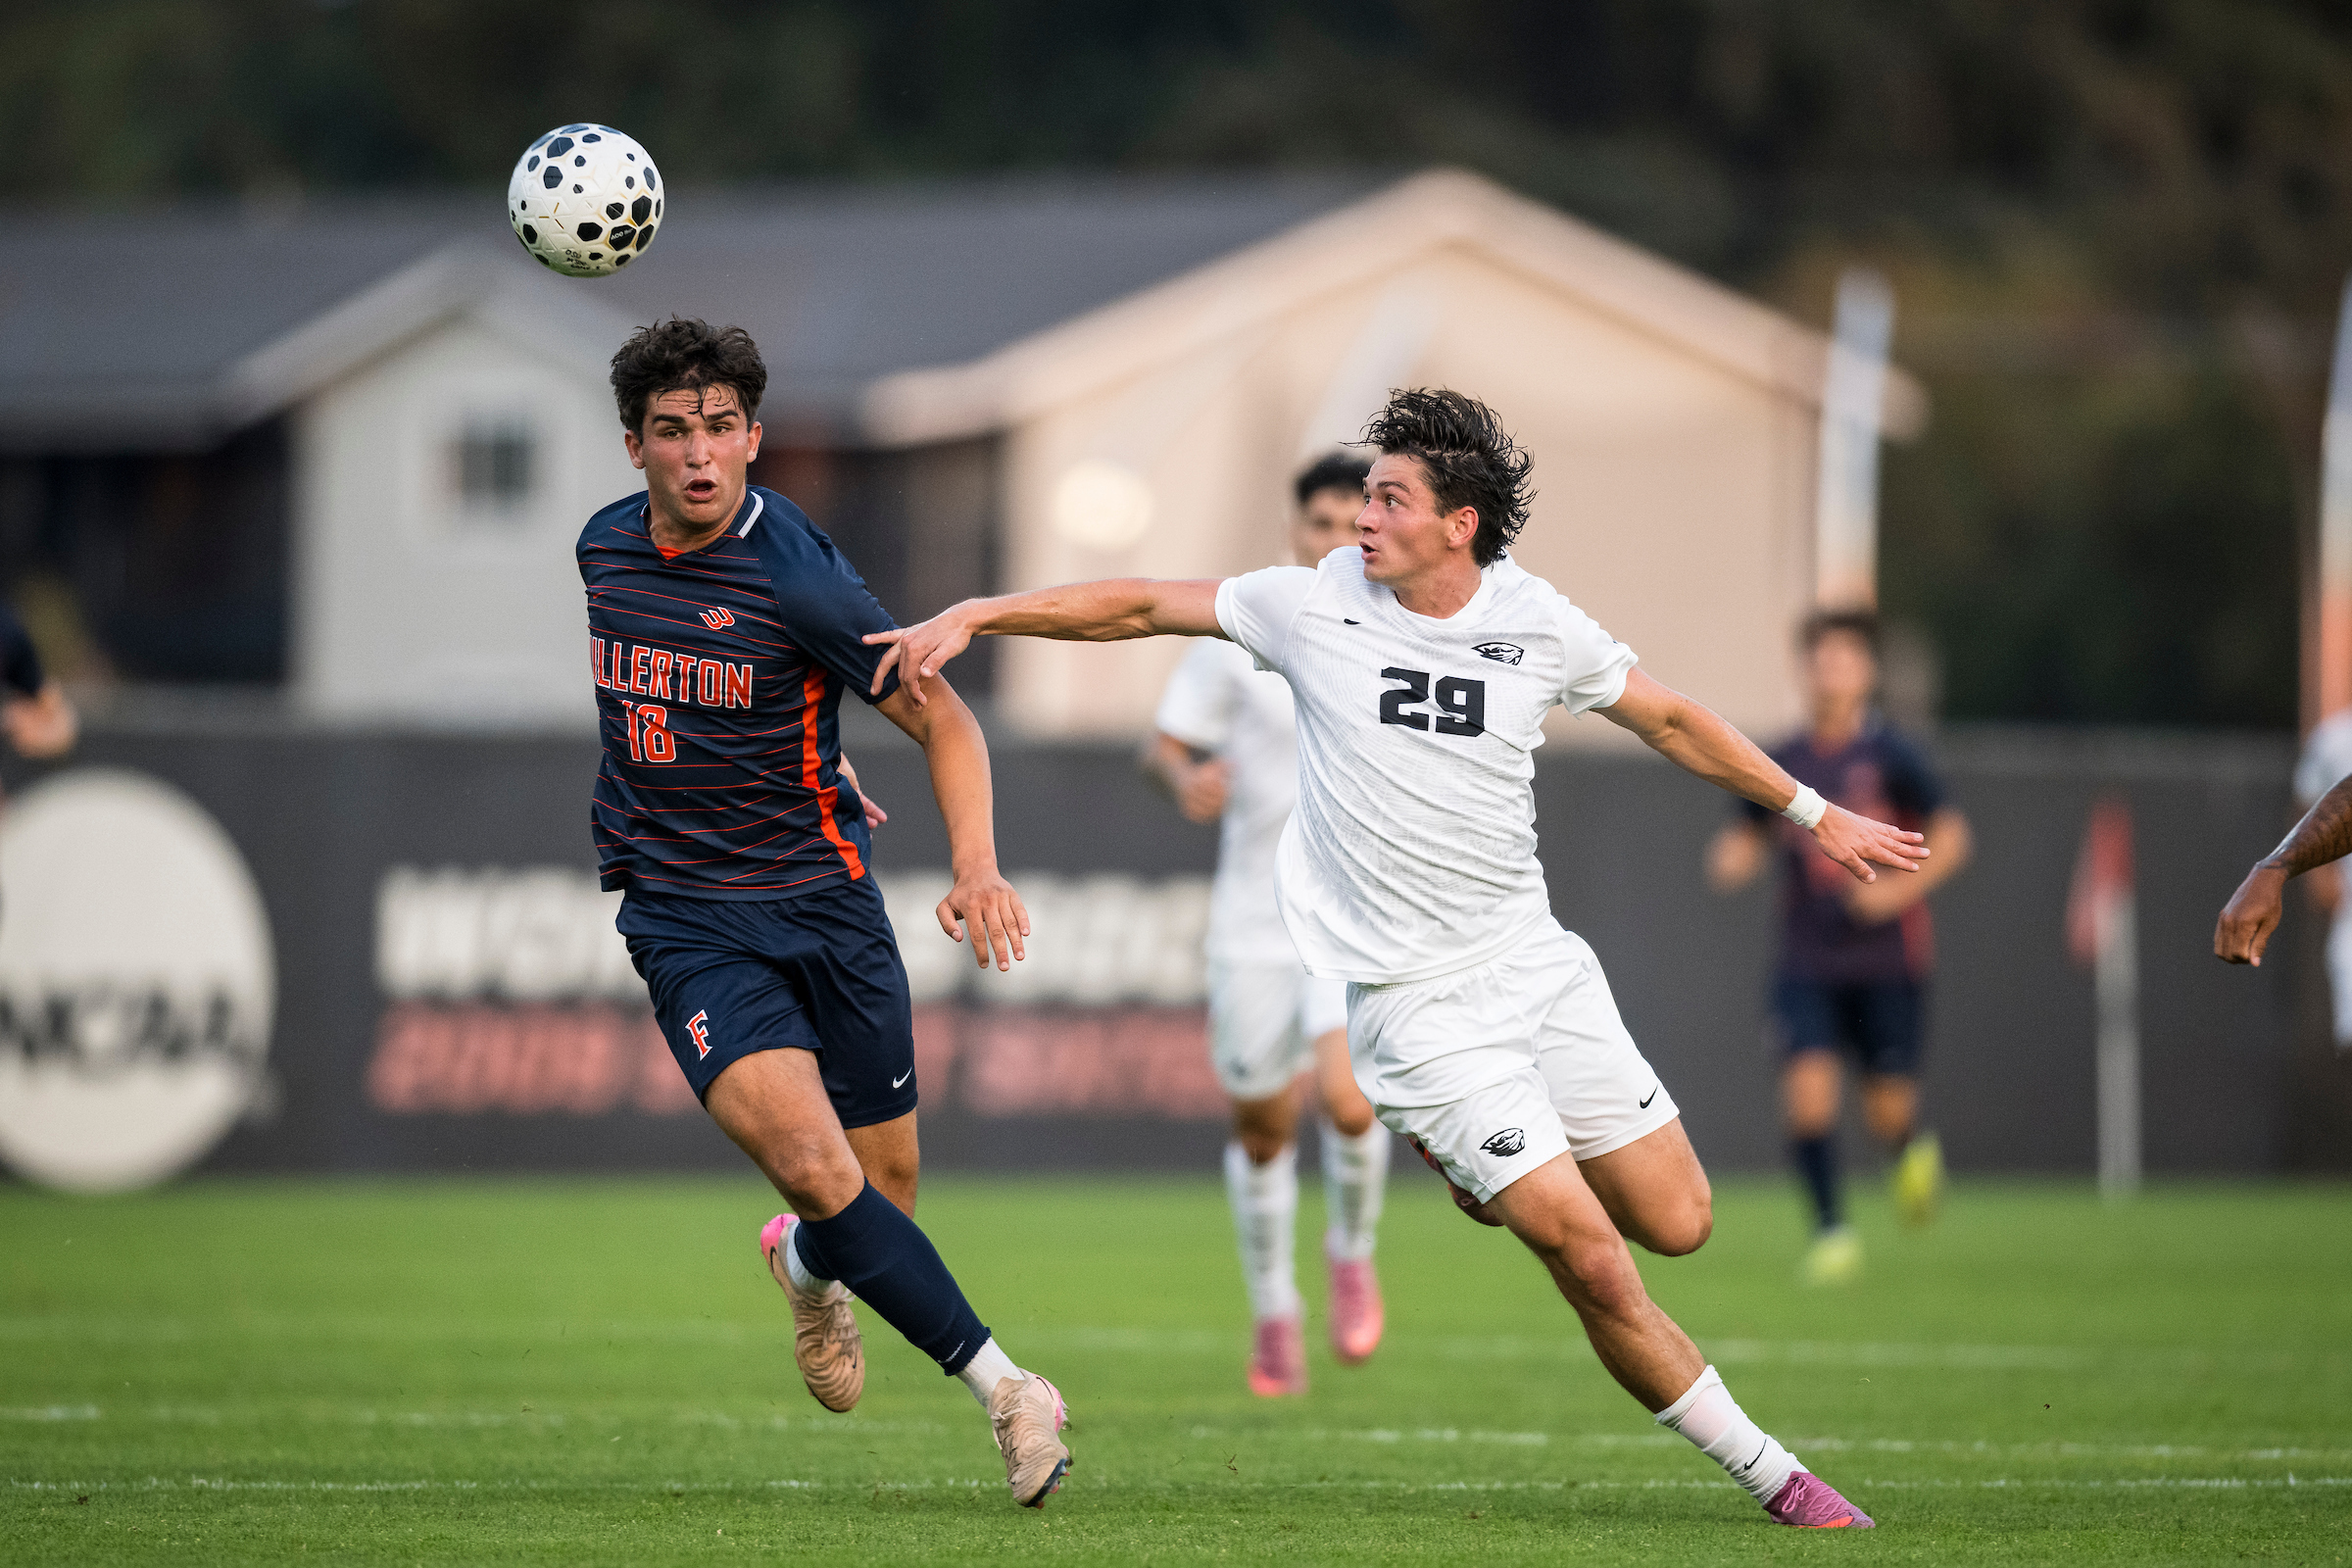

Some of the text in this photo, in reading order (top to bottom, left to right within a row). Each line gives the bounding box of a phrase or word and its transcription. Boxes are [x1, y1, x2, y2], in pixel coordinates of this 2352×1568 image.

[589, 634, 754, 710] ULLERTON
[1380, 666, 1486, 738] 29
[621, 700, 677, 762] 18
[684, 1008, 713, 1062] F
